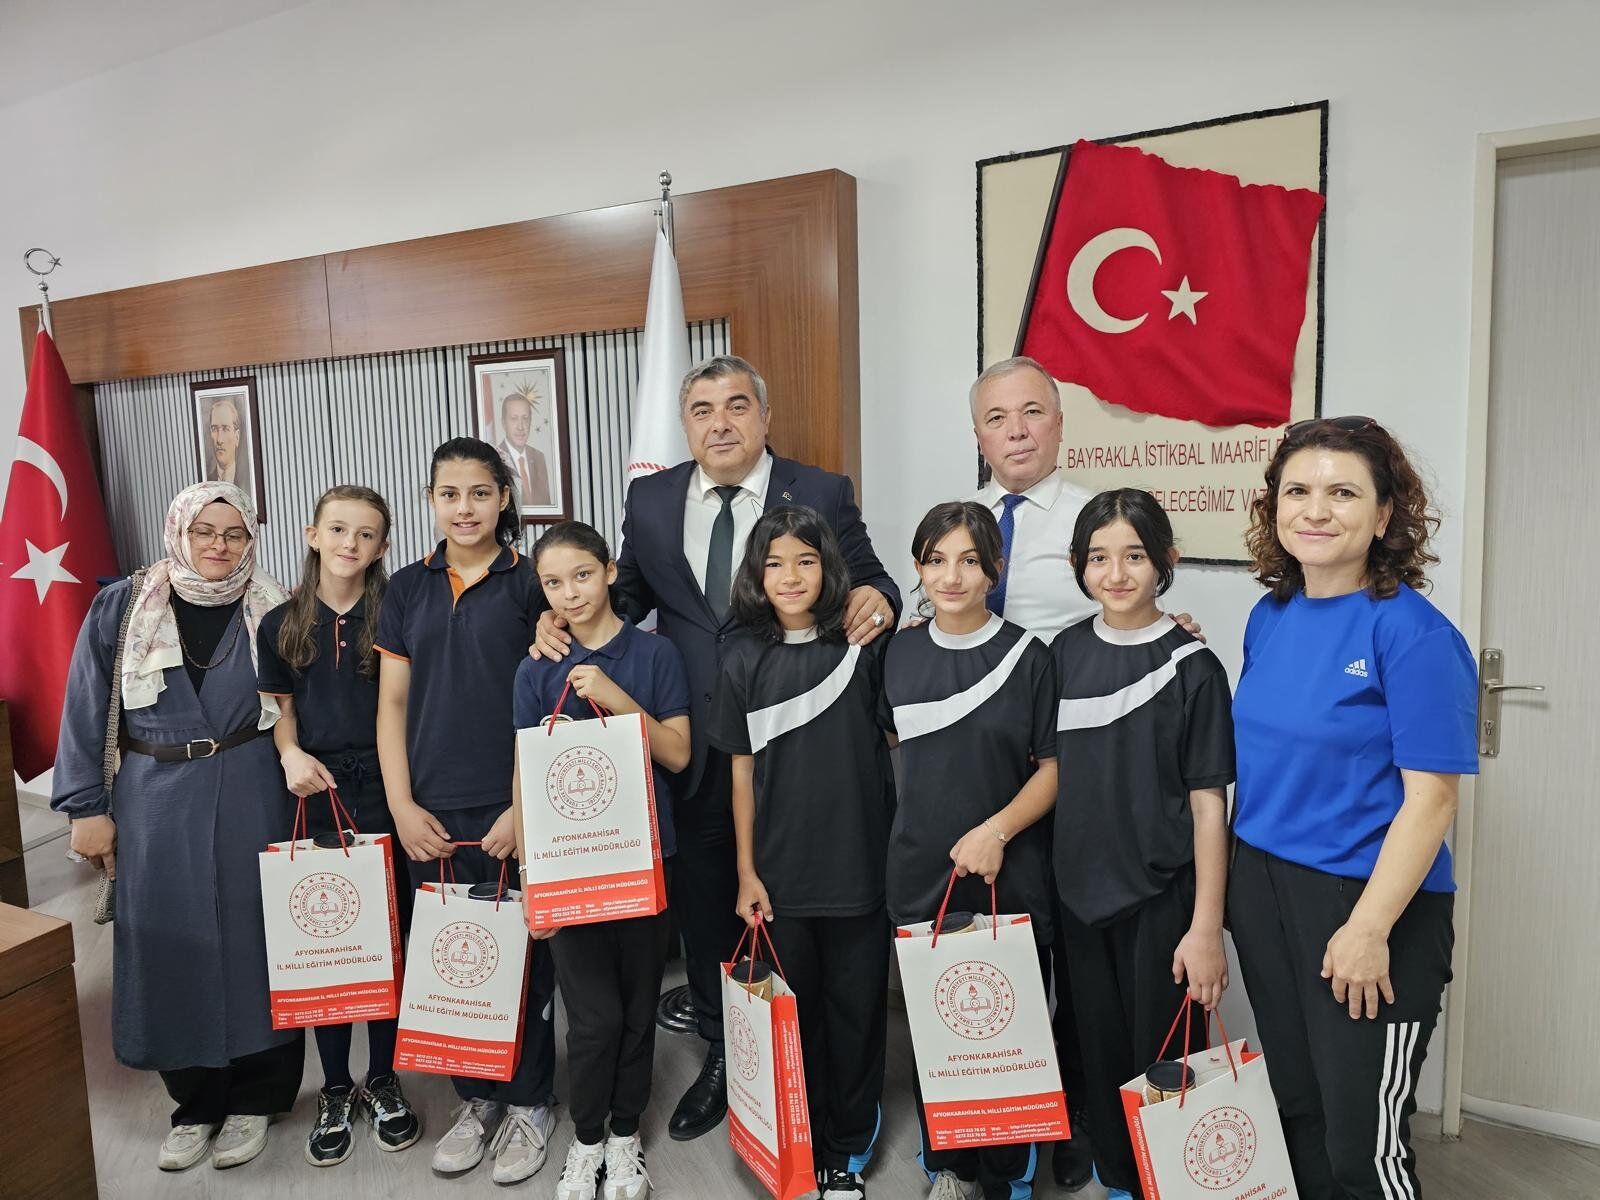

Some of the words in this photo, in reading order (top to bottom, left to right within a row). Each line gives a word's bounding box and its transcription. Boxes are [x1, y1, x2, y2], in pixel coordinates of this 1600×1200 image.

[1145, 440, 1205, 467] İSTİKBAL
[1149, 486, 1234, 512] ELECEĞİMİZ
[1344, 668, 1368, 678] adidas
[552, 829, 620, 843] AFYONKARAHİSAR
[534, 852, 540, 860] İL
[542, 850, 561, 859] MİLLİ
[563, 846, 589, 856] EĞİTİM
[592, 839, 641, 852] MÜDÜRLÜĞÜ
[295, 945, 362, 956] AFYONKARAHİSAR
[307, 960, 332, 969] EĞİTİM
[334, 954, 382, 966] MÜDÜRLÜĞÜ
[428, 994, 491, 1007] AFYONKARAHİSAR
[437, 1008, 460, 1016] EĞİTİM
[462, 1011, 509, 1021] MÜDÜRLÜĞÜ
[948, 1048, 1023, 1062] AFYONKARAHİSAR
[928, 1070, 936, 1078] İL
[938, 1067, 960, 1077] MİLLİ
[962, 1066, 990, 1076] EĞİTİM
[993, 1060, 1047, 1073] MÜDÜRLÜĞÜ
